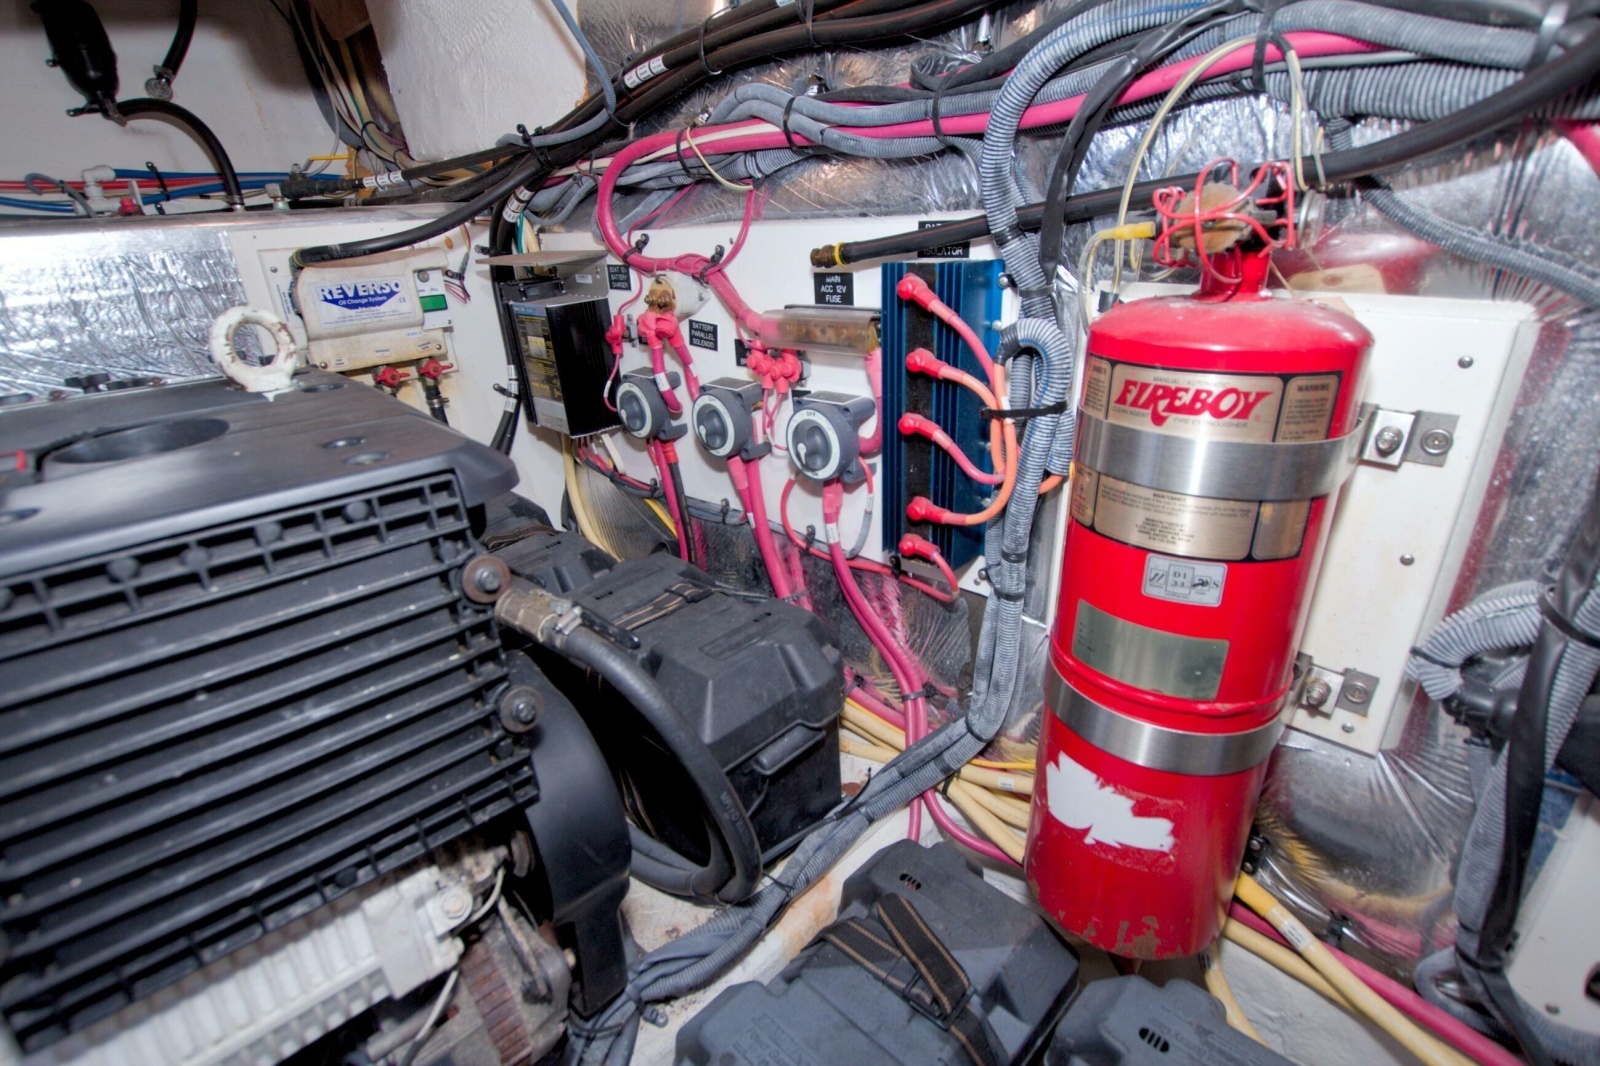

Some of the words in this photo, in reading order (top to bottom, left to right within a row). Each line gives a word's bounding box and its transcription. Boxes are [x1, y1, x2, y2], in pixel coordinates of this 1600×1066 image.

[923, 246, 963, 256] ISOLATOR
[825, 275, 841, 283] MAIN
[317, 280, 401, 300] REVERSO
[820, 284, 834, 293] ACC
[835, 284, 847, 293] 12V
[825, 294, 842, 303] FUSE
[692, 321, 714, 332] BATTERY
[691, 330, 715, 341] PARALLEL
[693, 338, 715, 348] SOLENOID
[1297, 383, 1330, 392] WARNING
[1114, 379, 1274, 428] FIREBOY
[1112, 405, 1129, 414] CLEAN
[1130, 409, 1150, 418] AGENT
